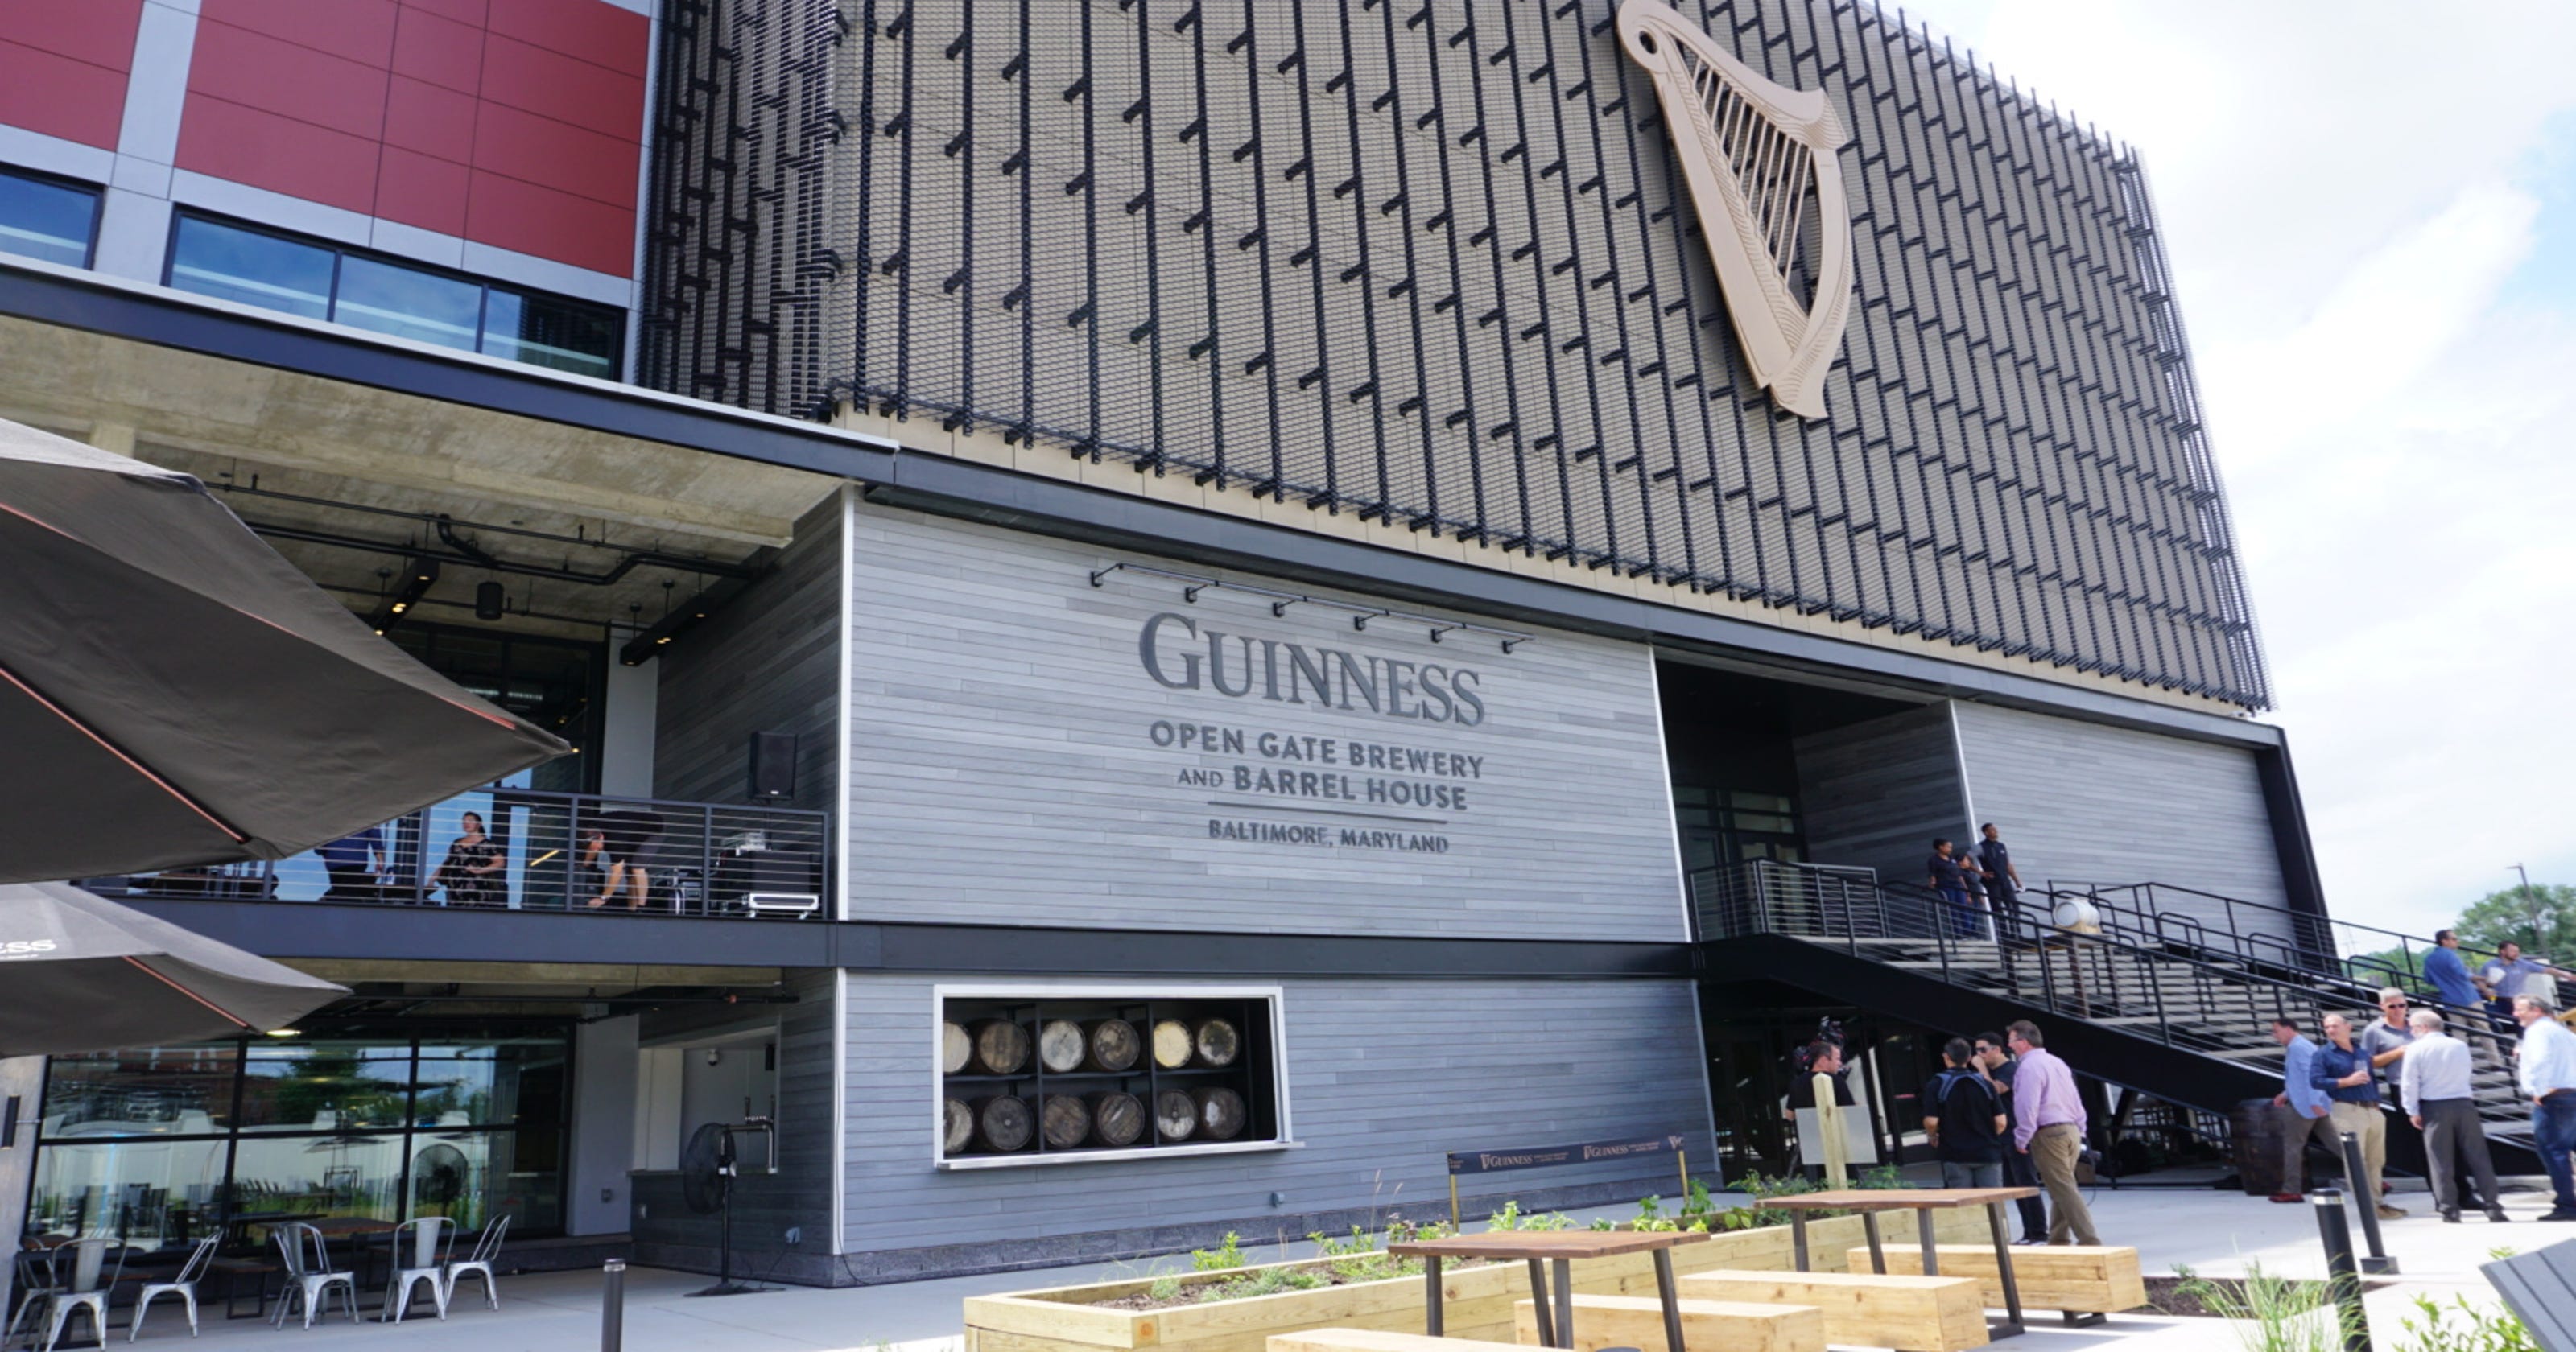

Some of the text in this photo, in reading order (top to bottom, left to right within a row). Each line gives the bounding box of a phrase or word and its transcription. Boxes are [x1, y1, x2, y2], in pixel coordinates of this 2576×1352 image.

[1139, 612, 1485, 725] GUINNESS
[1150, 720, 1484, 779] OPEN GATE BREWERY
[1178, 765, 1468, 810] AND BARREL HOUSE
[1209, 819, 1450, 853] BALTIMORE, MARYLAND
[1490, 1155, 1534, 1167] GUINNESS
